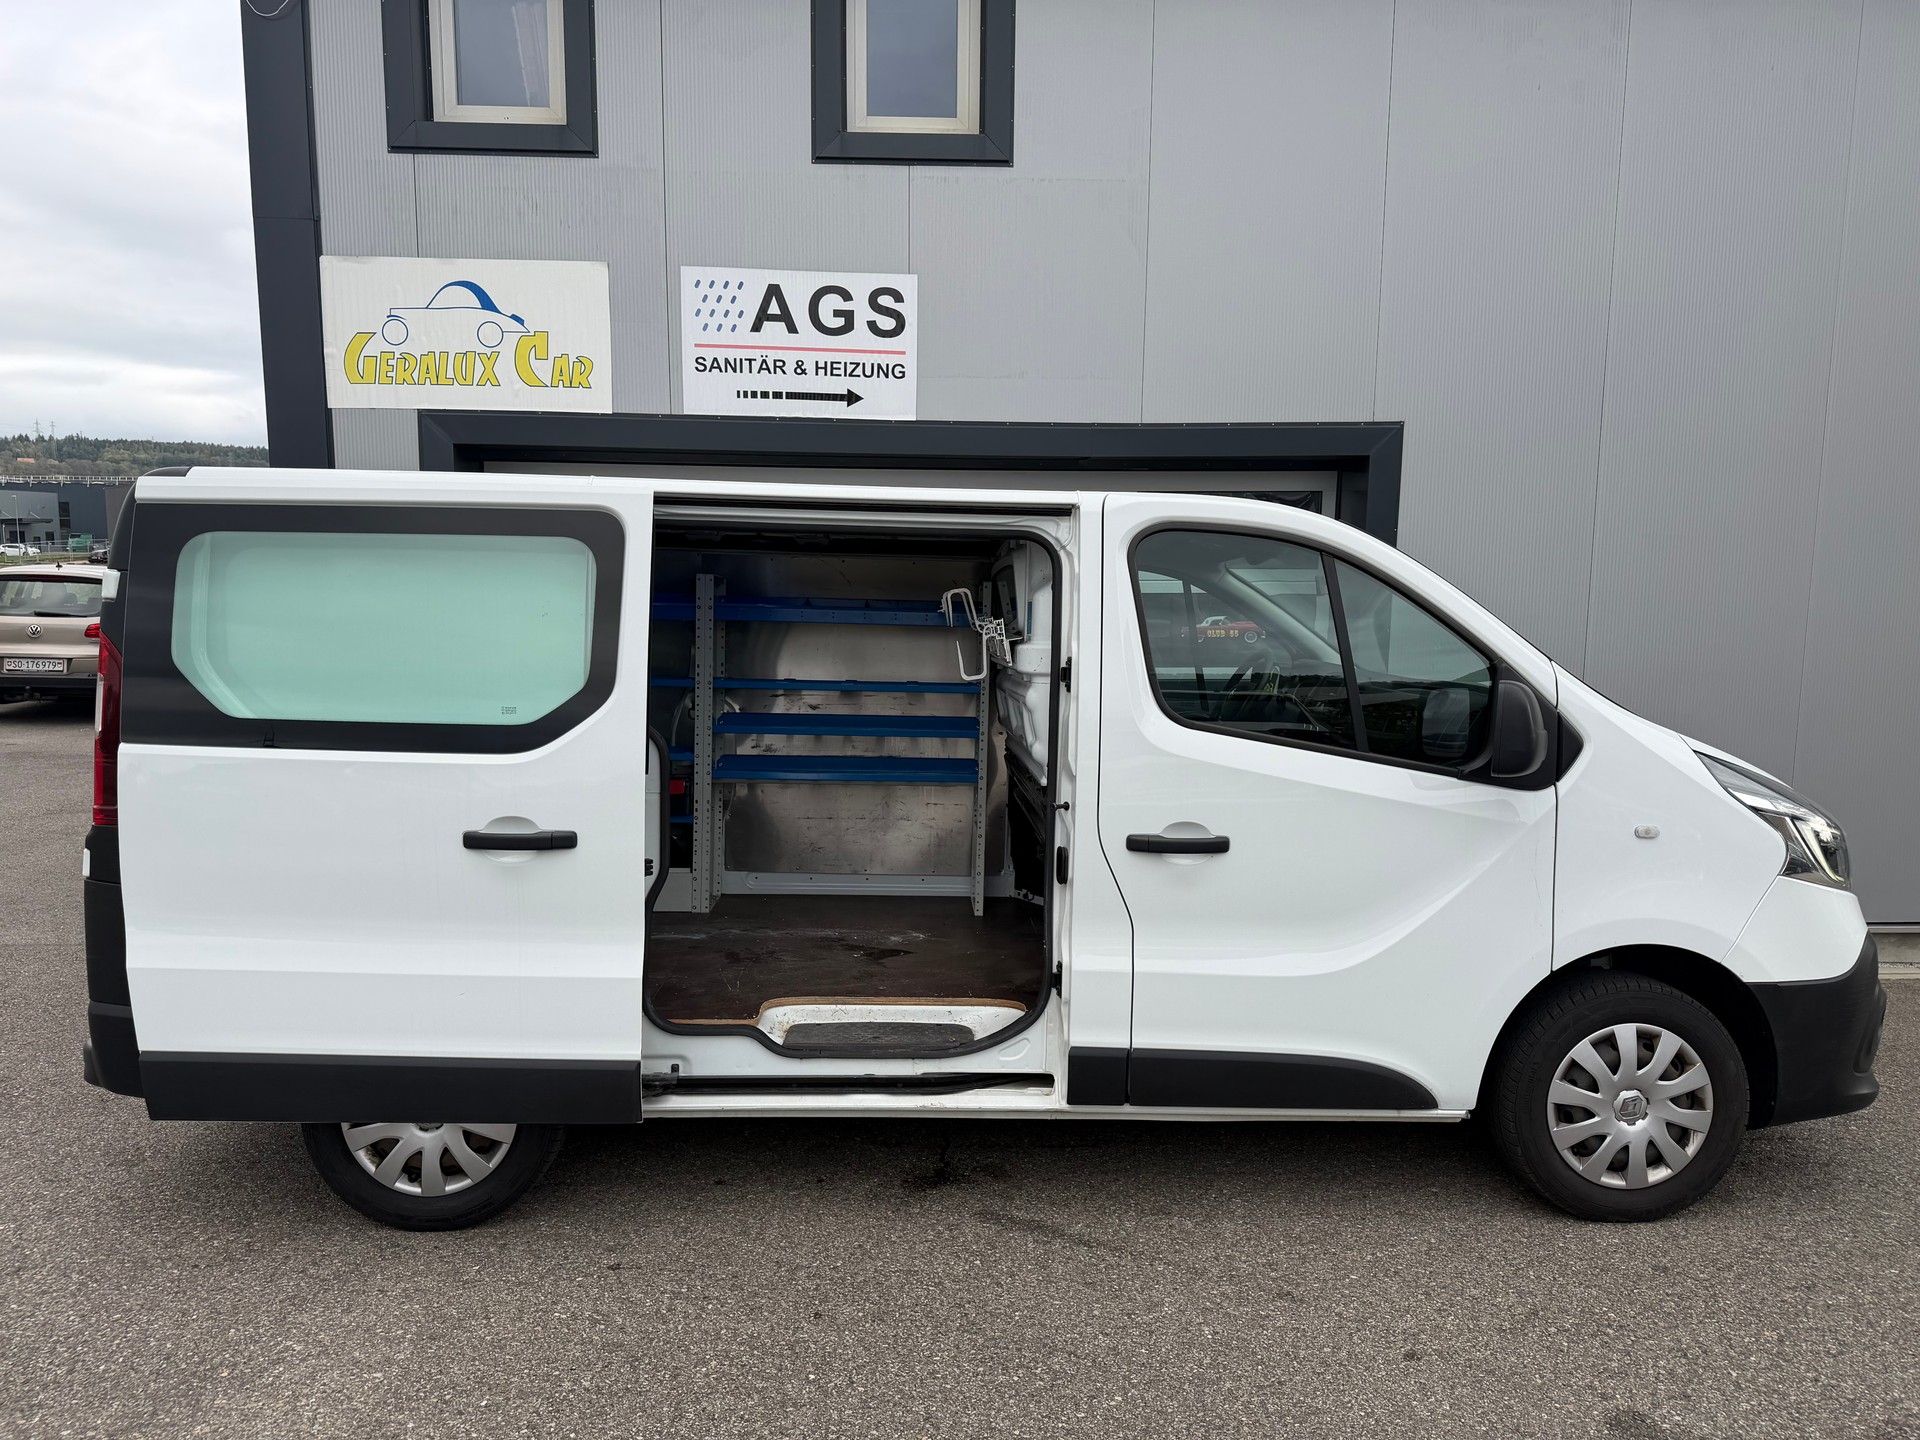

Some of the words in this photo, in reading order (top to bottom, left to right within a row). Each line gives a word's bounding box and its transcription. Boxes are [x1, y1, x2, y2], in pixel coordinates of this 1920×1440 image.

[750, 283, 906, 338] AGS
[694, 355, 787, 376] SANITÄR
[793, 359, 808, 376] &
[815, 360, 906, 379] HEIZUNG
[1229, 629, 1239, 638] 55
